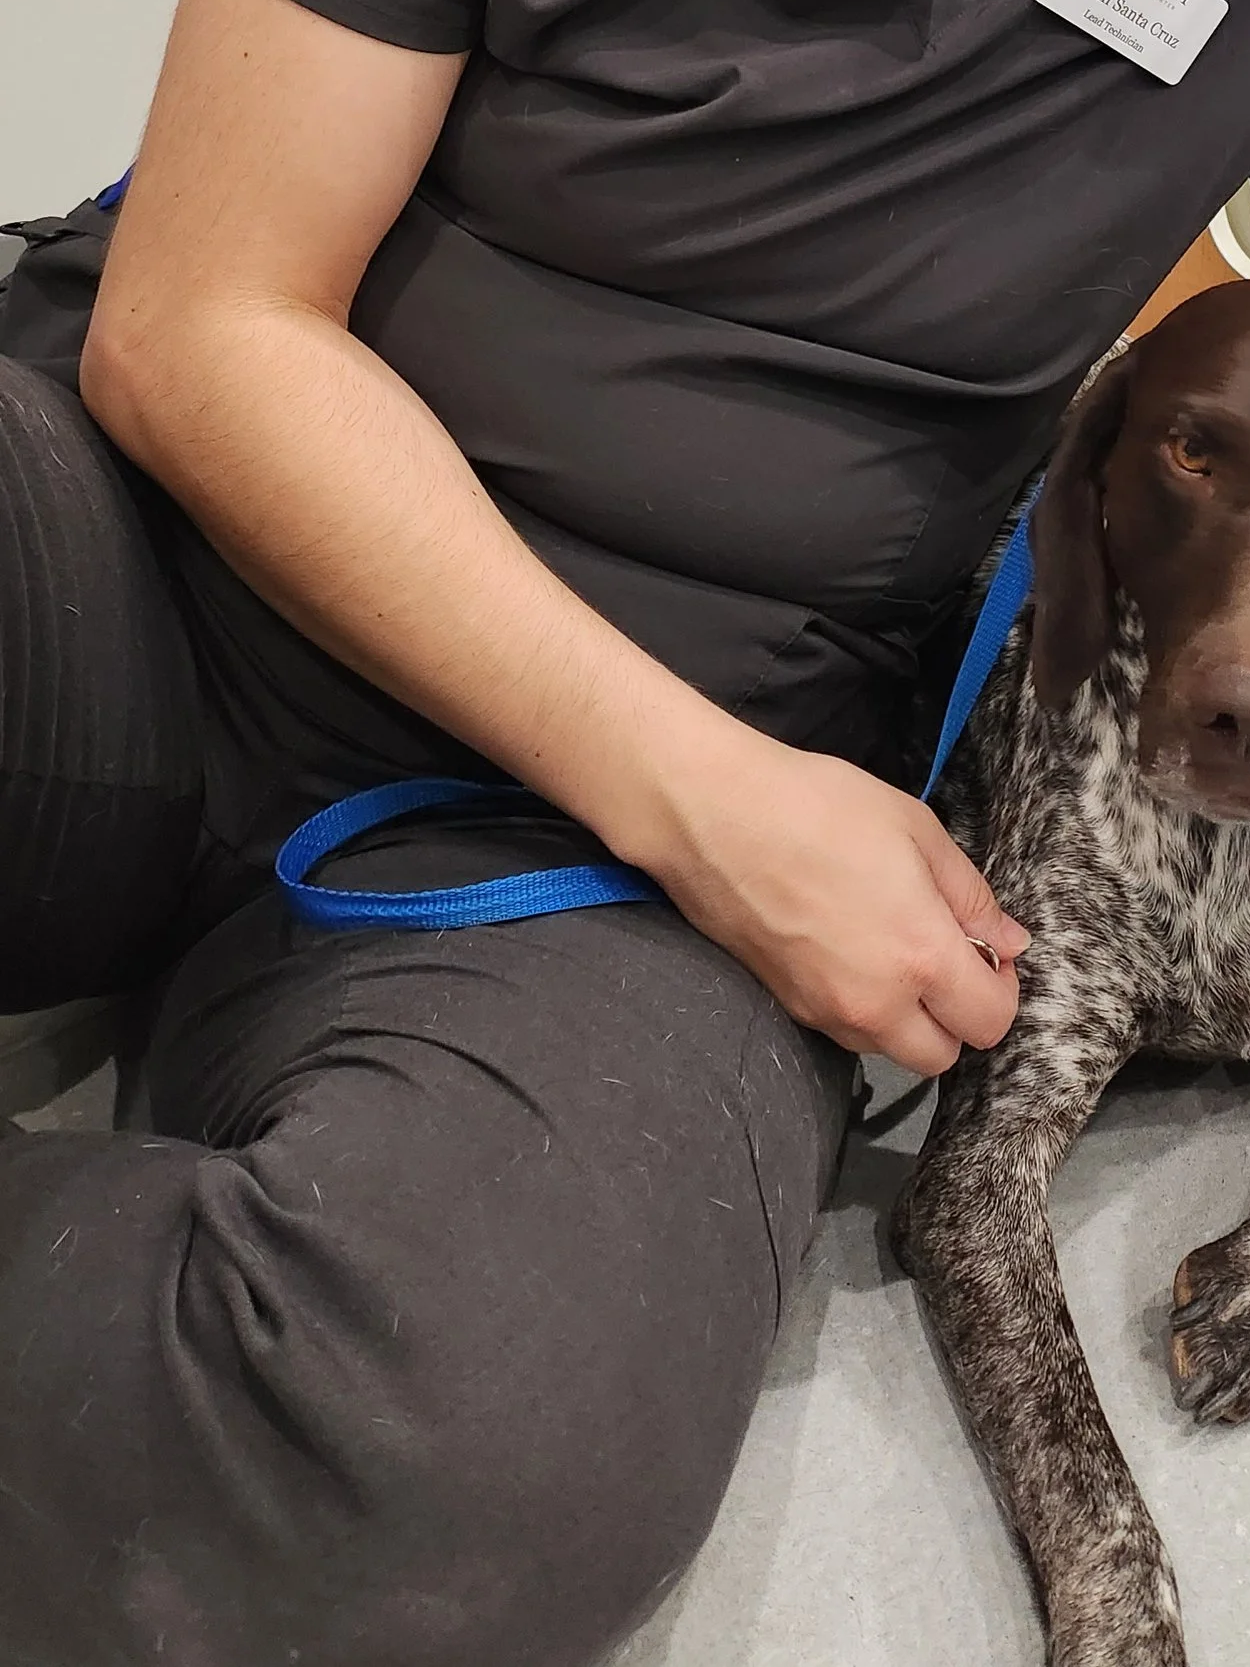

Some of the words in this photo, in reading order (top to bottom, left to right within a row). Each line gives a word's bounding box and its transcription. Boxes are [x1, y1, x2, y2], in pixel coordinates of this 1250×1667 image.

[1083, 9, 1105, 27] Lead
[1104, 21, 1144, 53] Technician
[1150, 22, 1179, 49] Cruz
